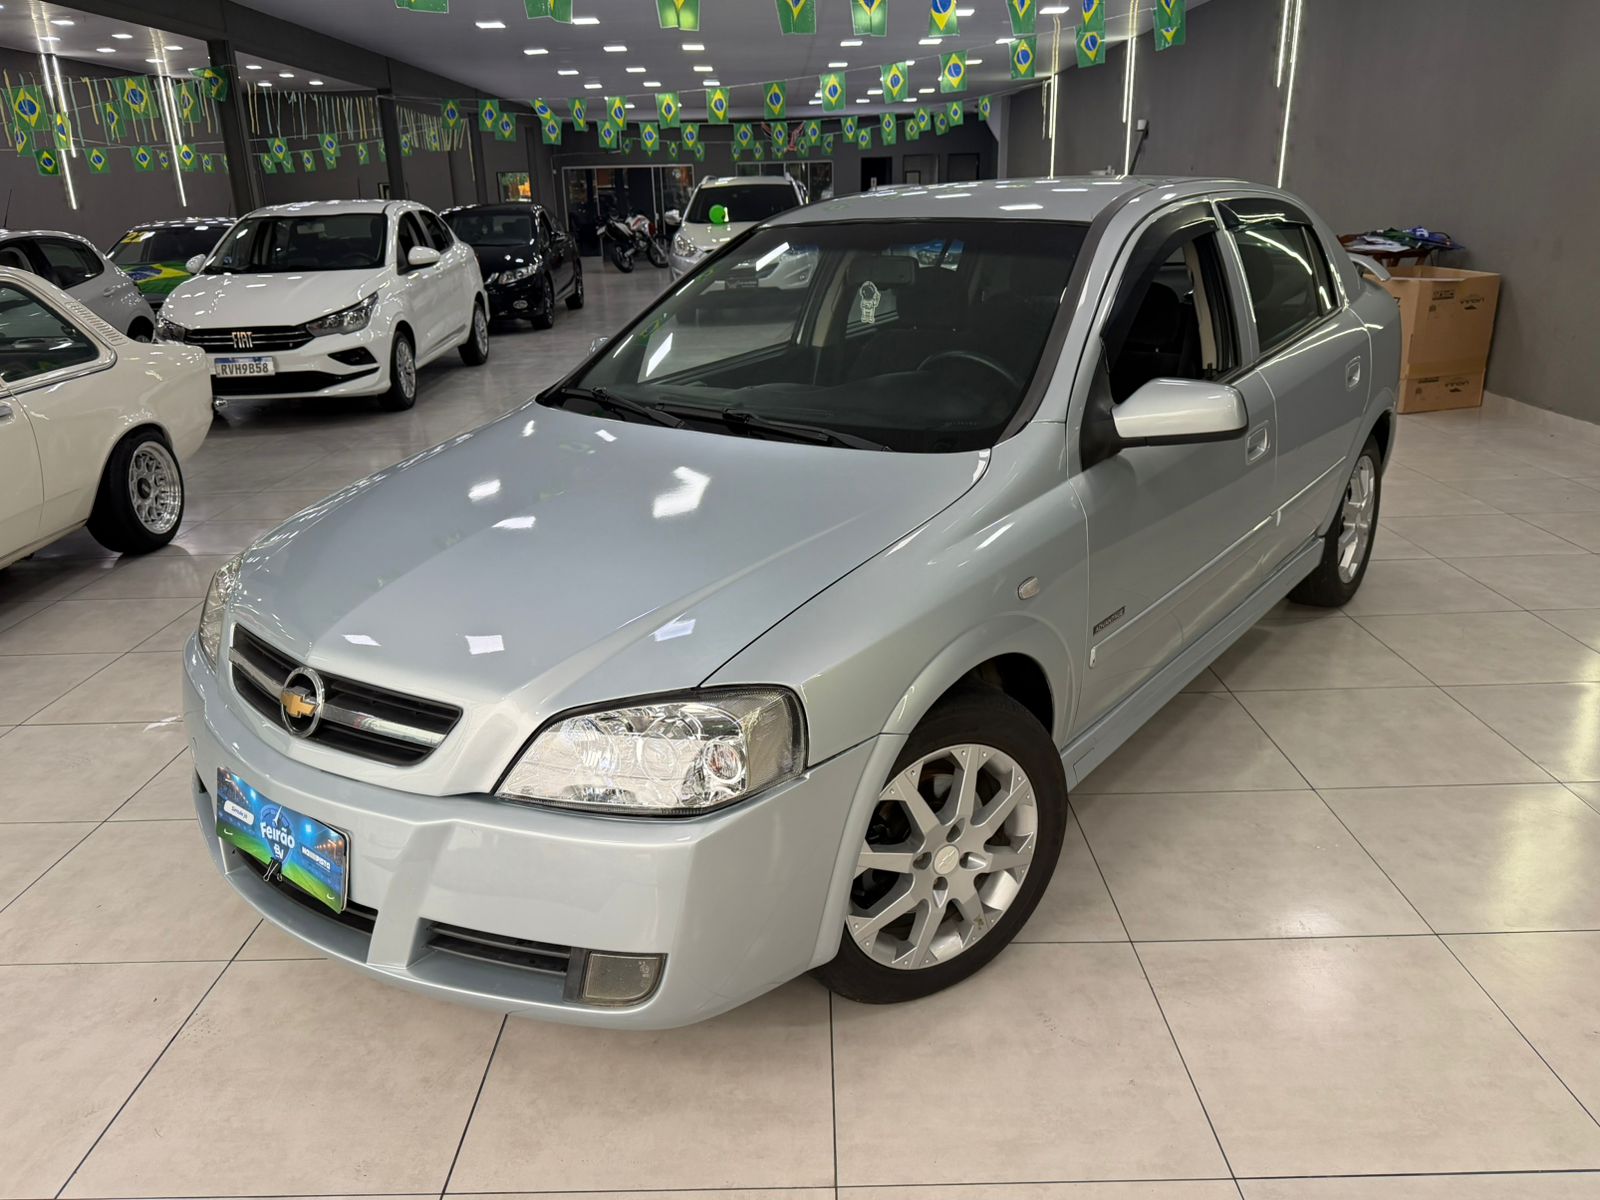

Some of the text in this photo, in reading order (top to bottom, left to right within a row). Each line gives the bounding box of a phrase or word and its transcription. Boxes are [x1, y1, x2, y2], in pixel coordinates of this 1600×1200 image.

[231, 331, 253, 348] FIAT
[220, 362, 269, 375] RVH9B58
[260, 821, 296, 849] Feirão
